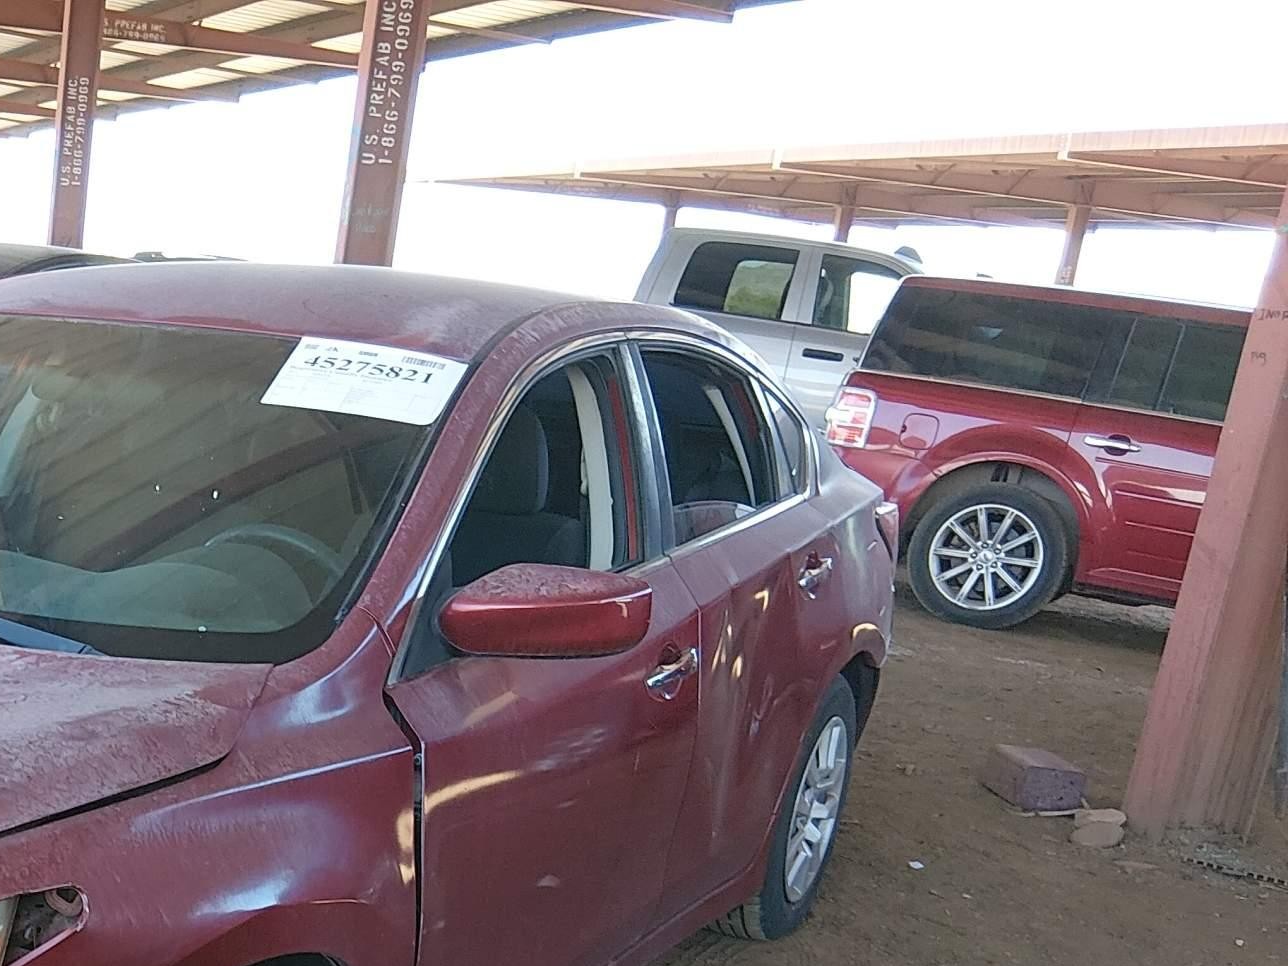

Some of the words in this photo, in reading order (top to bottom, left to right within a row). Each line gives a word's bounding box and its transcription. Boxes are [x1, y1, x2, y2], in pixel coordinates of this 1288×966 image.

[369, 42, 391, 117] PREFAB
[378, 0, 414, 164] 1-866-799-0969
[63, 106, 76, 155] PREFAB
[304, 355, 433, 384] 45275821
